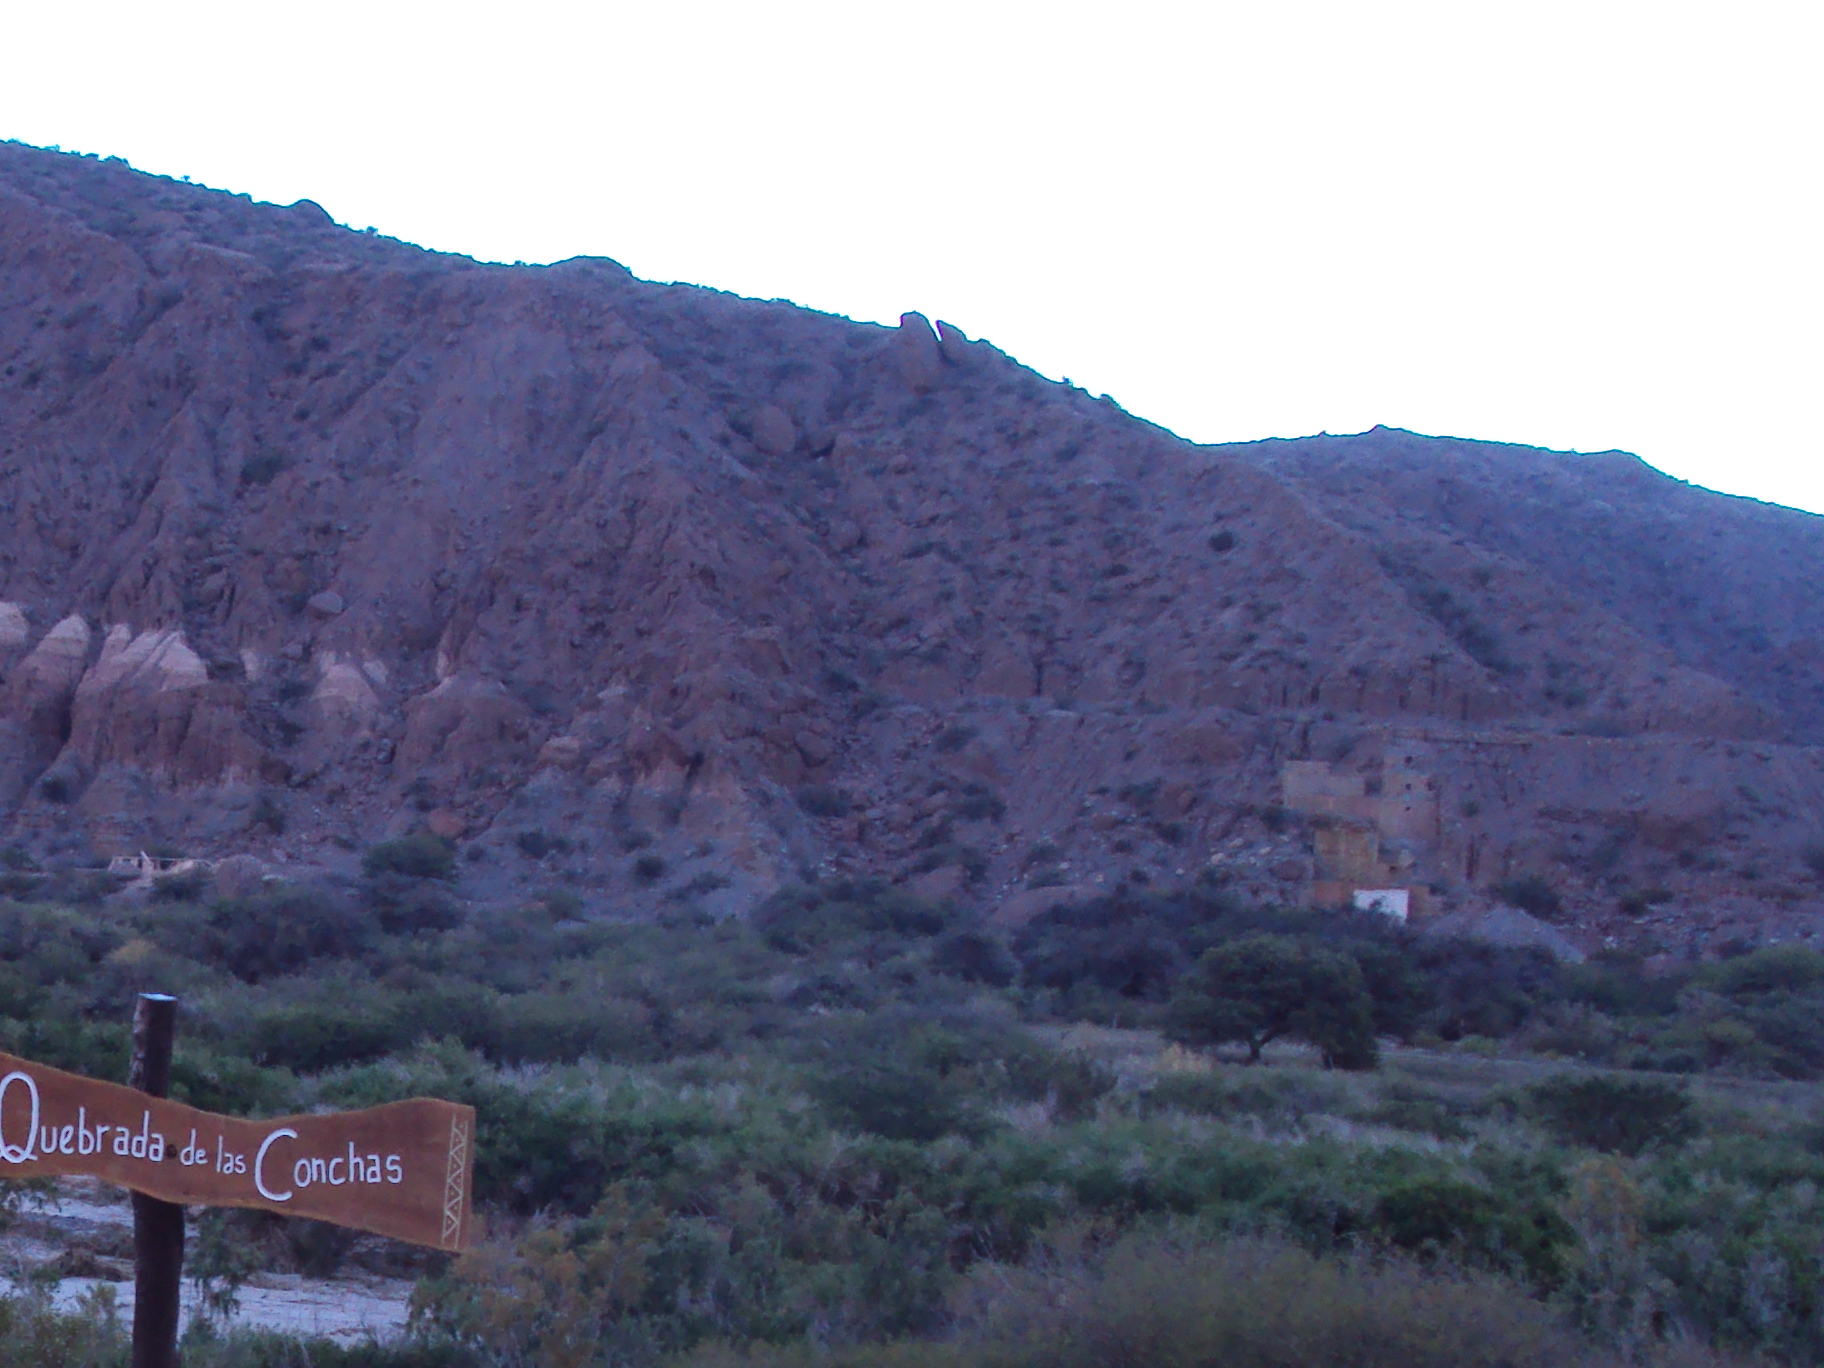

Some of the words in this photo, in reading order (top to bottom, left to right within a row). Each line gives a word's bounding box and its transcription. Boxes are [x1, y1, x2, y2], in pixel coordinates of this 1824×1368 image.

[179, 1128, 208, 1166] de
[216, 1135, 247, 1175] las
[253, 1127, 404, 1202] Conchas
